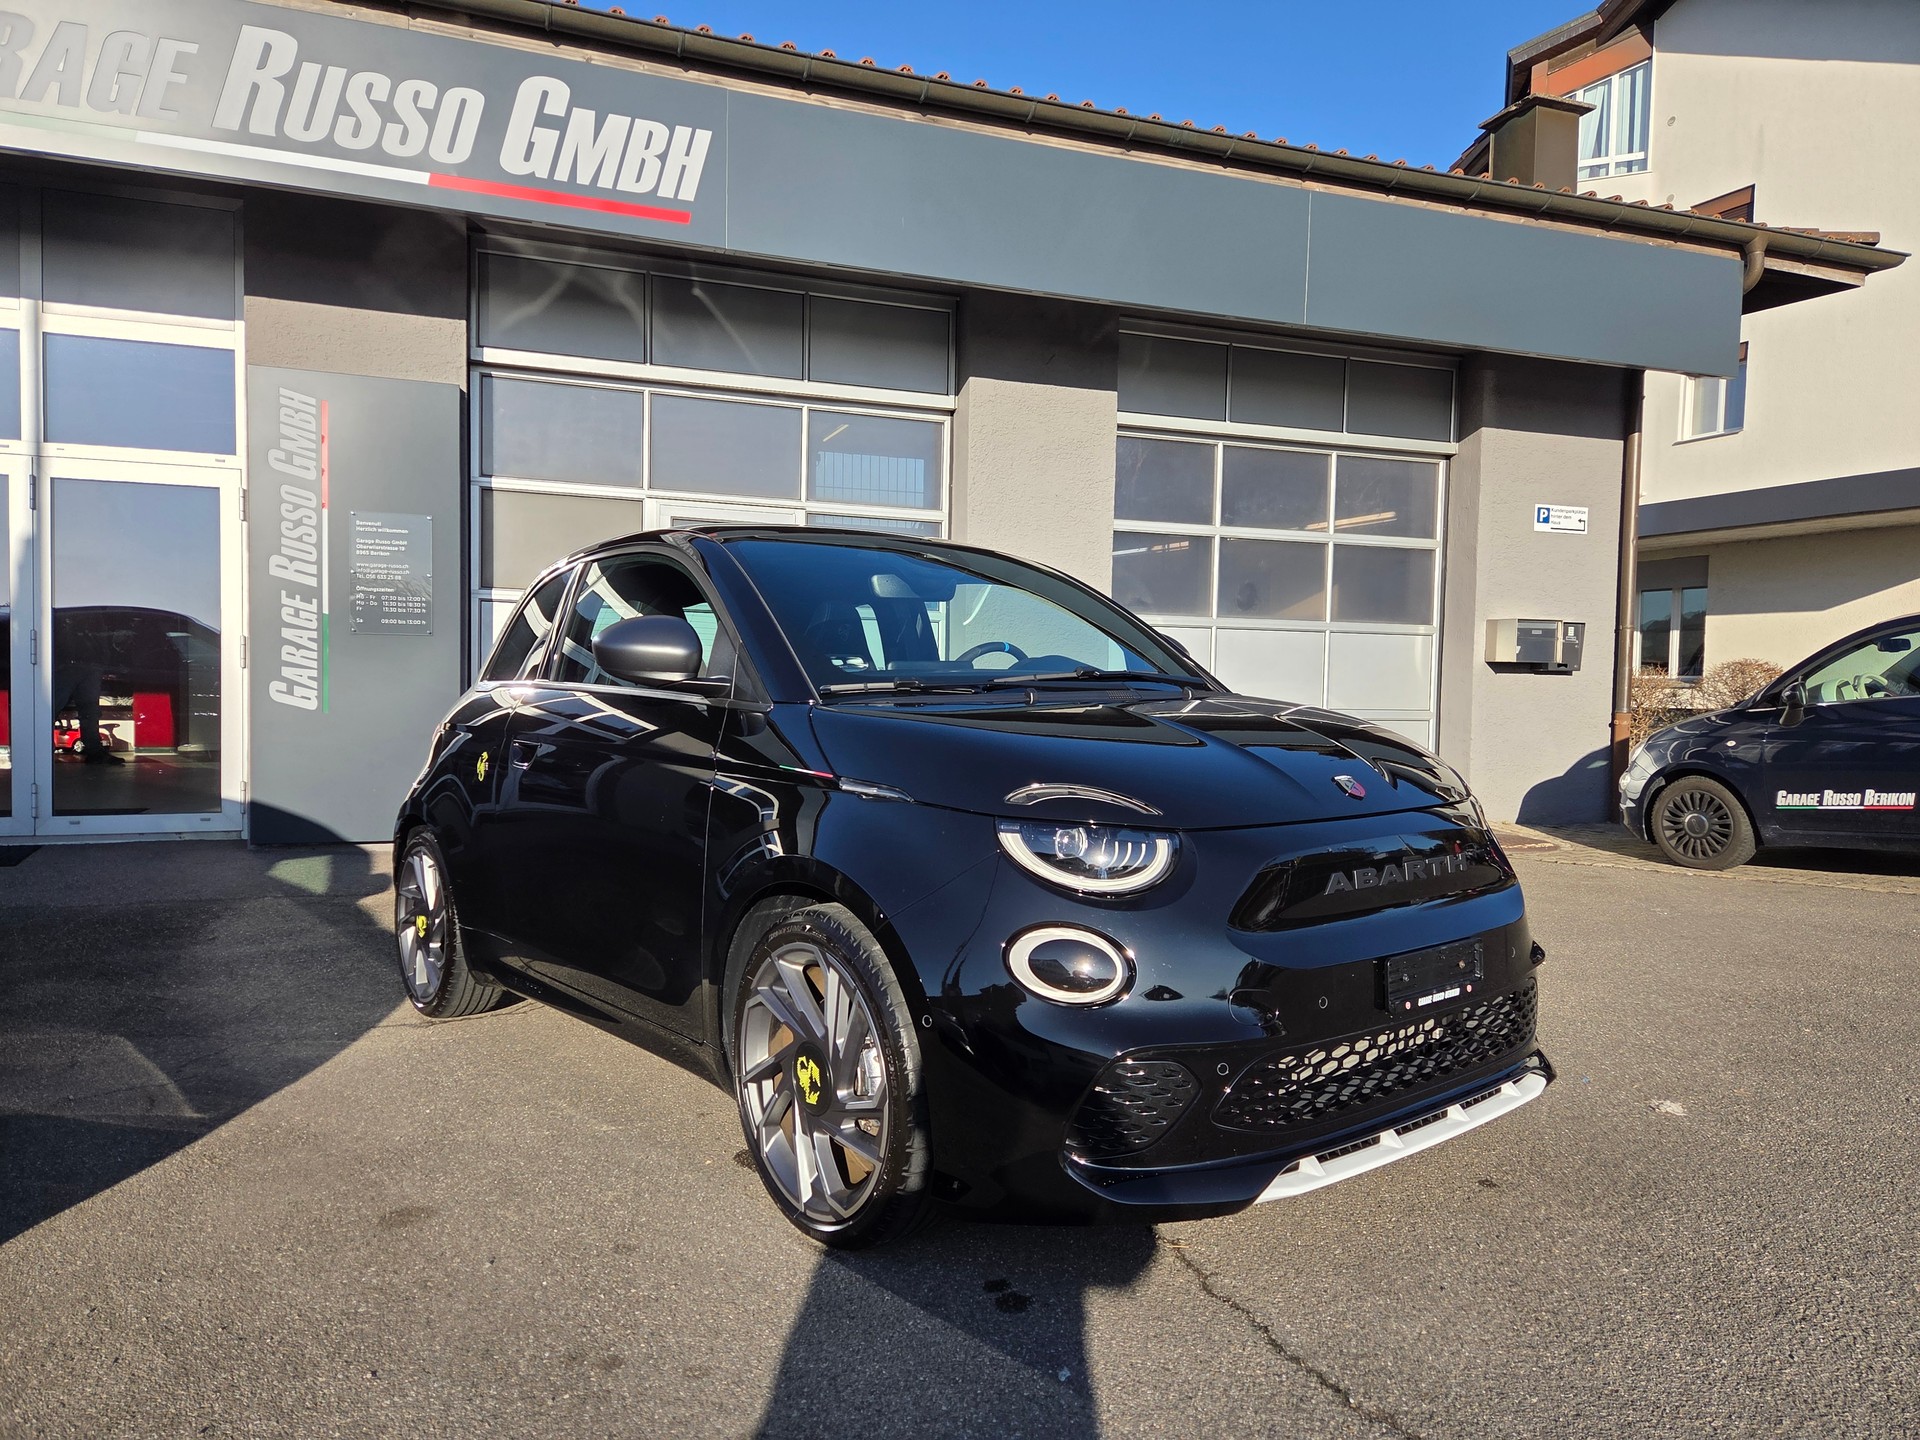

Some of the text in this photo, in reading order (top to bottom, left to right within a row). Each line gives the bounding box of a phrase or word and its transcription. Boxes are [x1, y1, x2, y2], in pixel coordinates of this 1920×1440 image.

[212, 25, 485, 164] RUSSO
[500, 75, 712, 202] GMBH
[268, 387, 318, 711] GARAGE RUSSO GMBH
[1776, 788, 1916, 806] GARAGE RUSSO BERIKON
[1324, 853, 1470, 896] ABARTH
